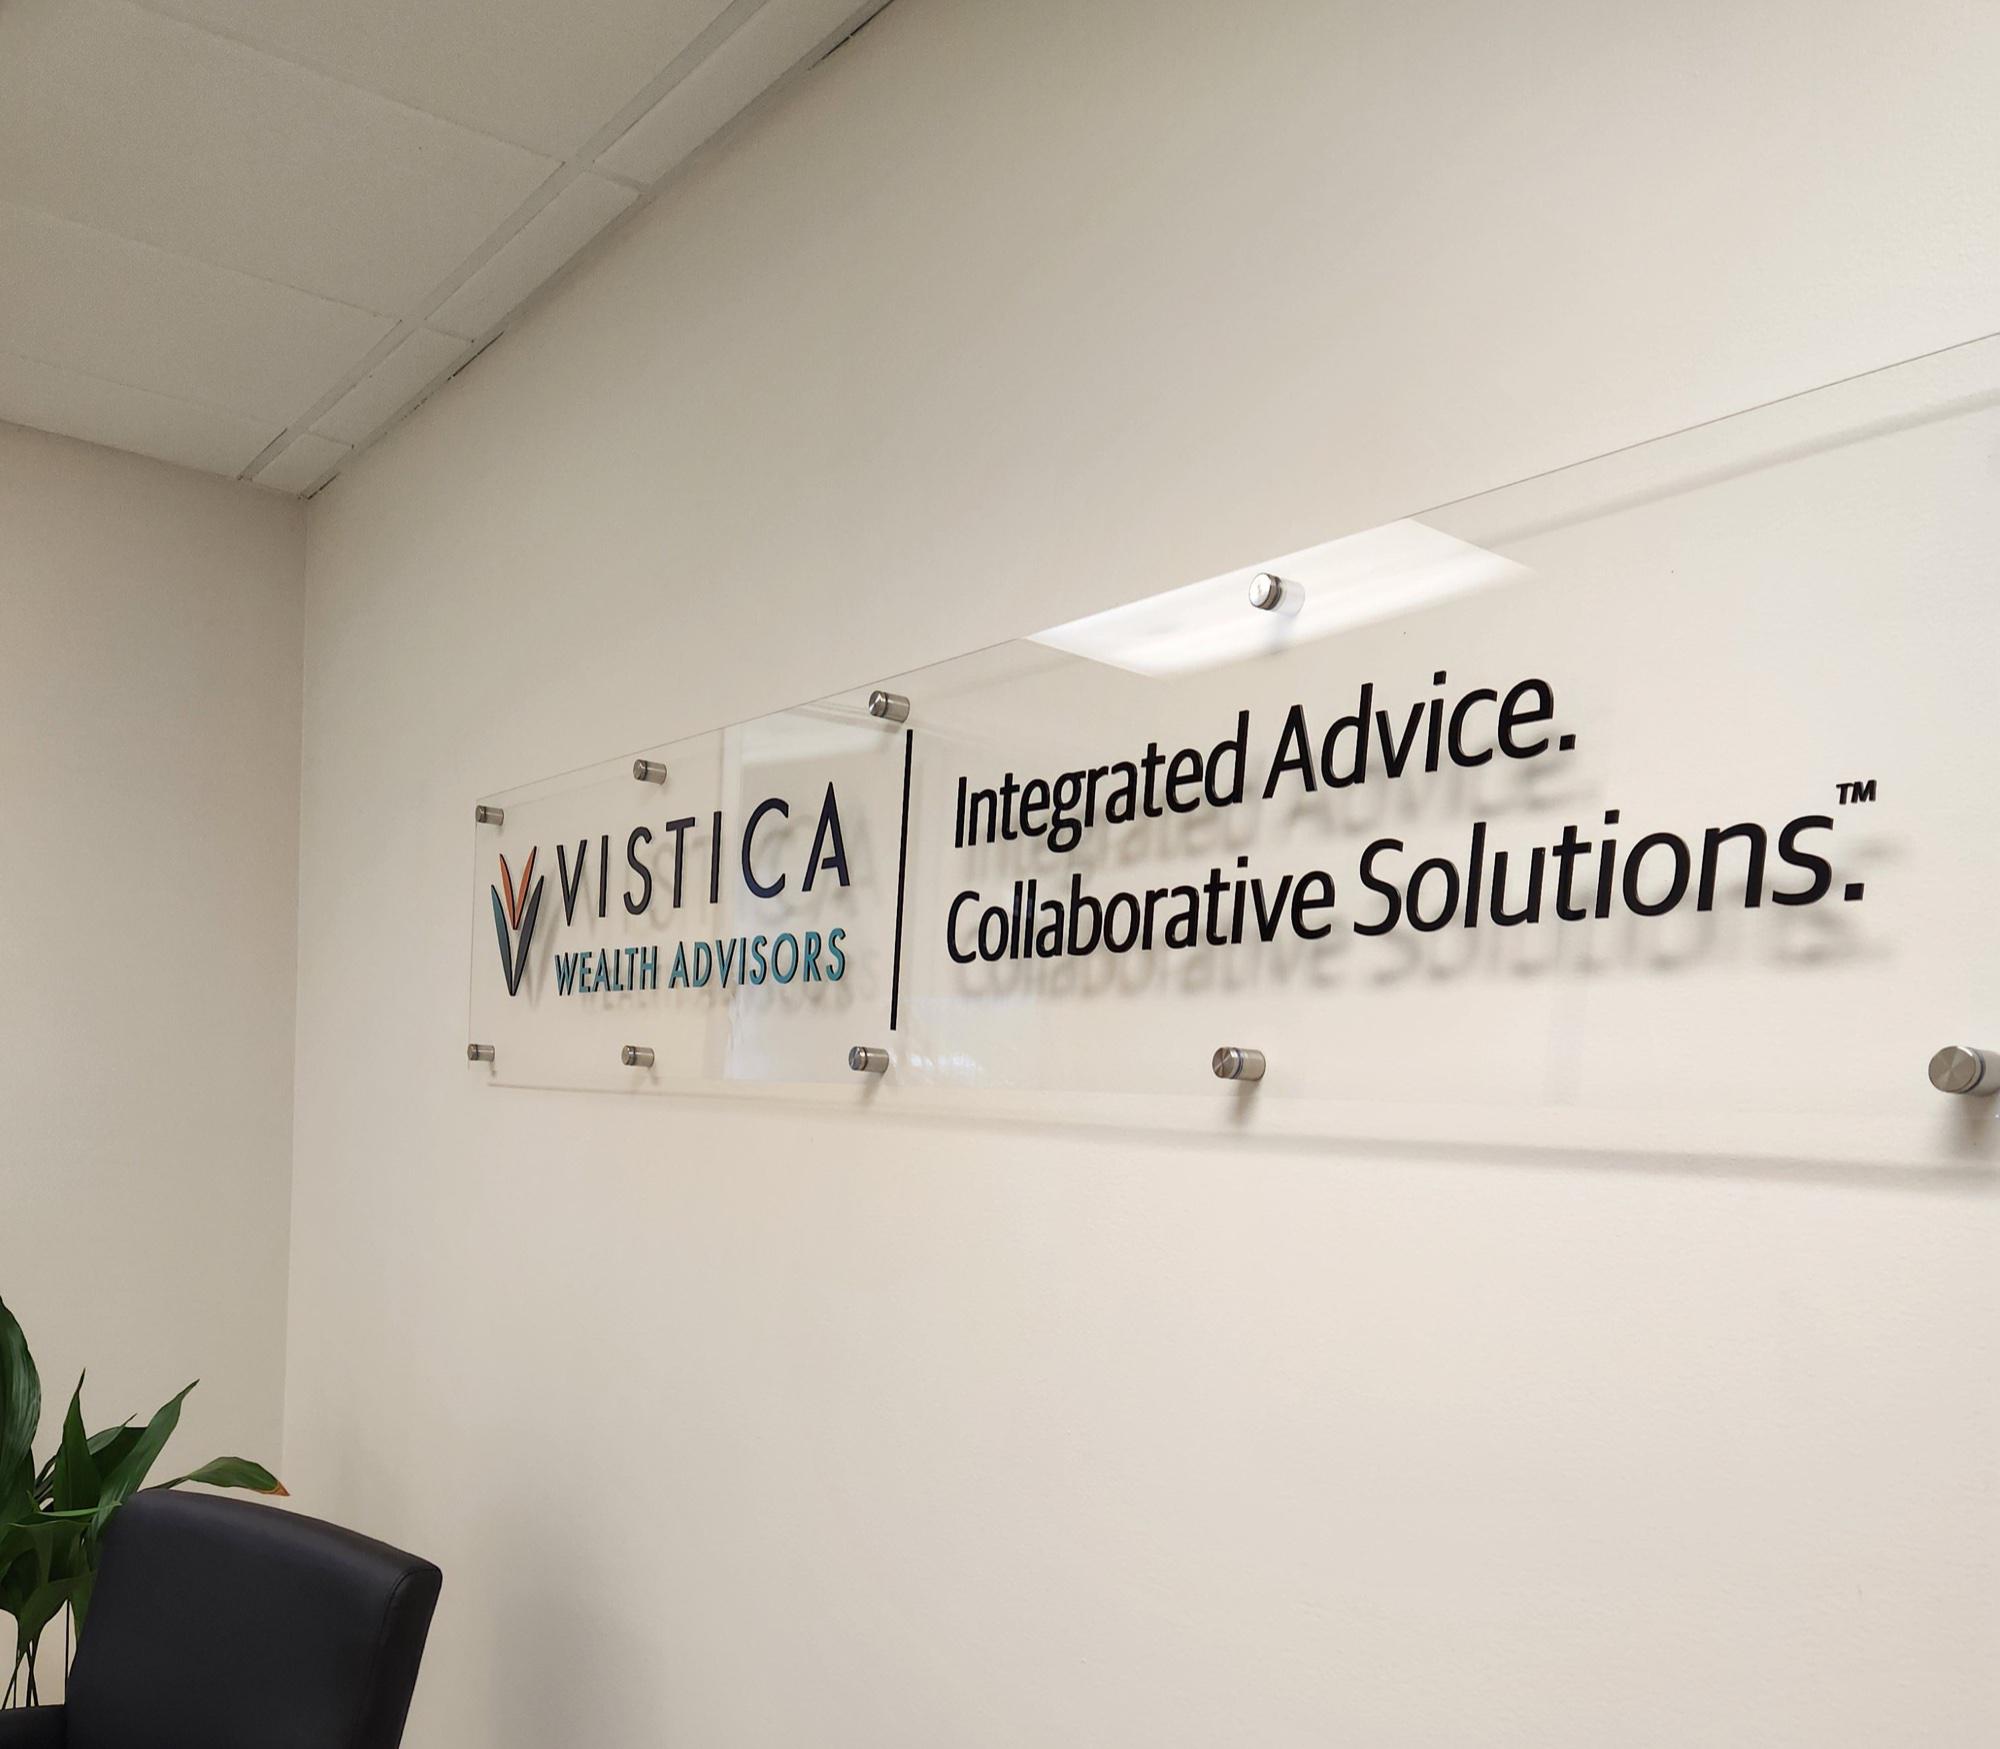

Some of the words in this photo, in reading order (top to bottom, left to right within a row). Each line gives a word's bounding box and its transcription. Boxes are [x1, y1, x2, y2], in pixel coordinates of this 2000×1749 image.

[954, 709, 1250, 852] Integrated
[1262, 670, 1577, 799] Advice.
[556, 781, 851, 926] VISTICA
[947, 855, 1336, 963] Collaborative
[555, 945, 658, 997] WEALTH
[668, 927, 847, 989] ADVISORS
